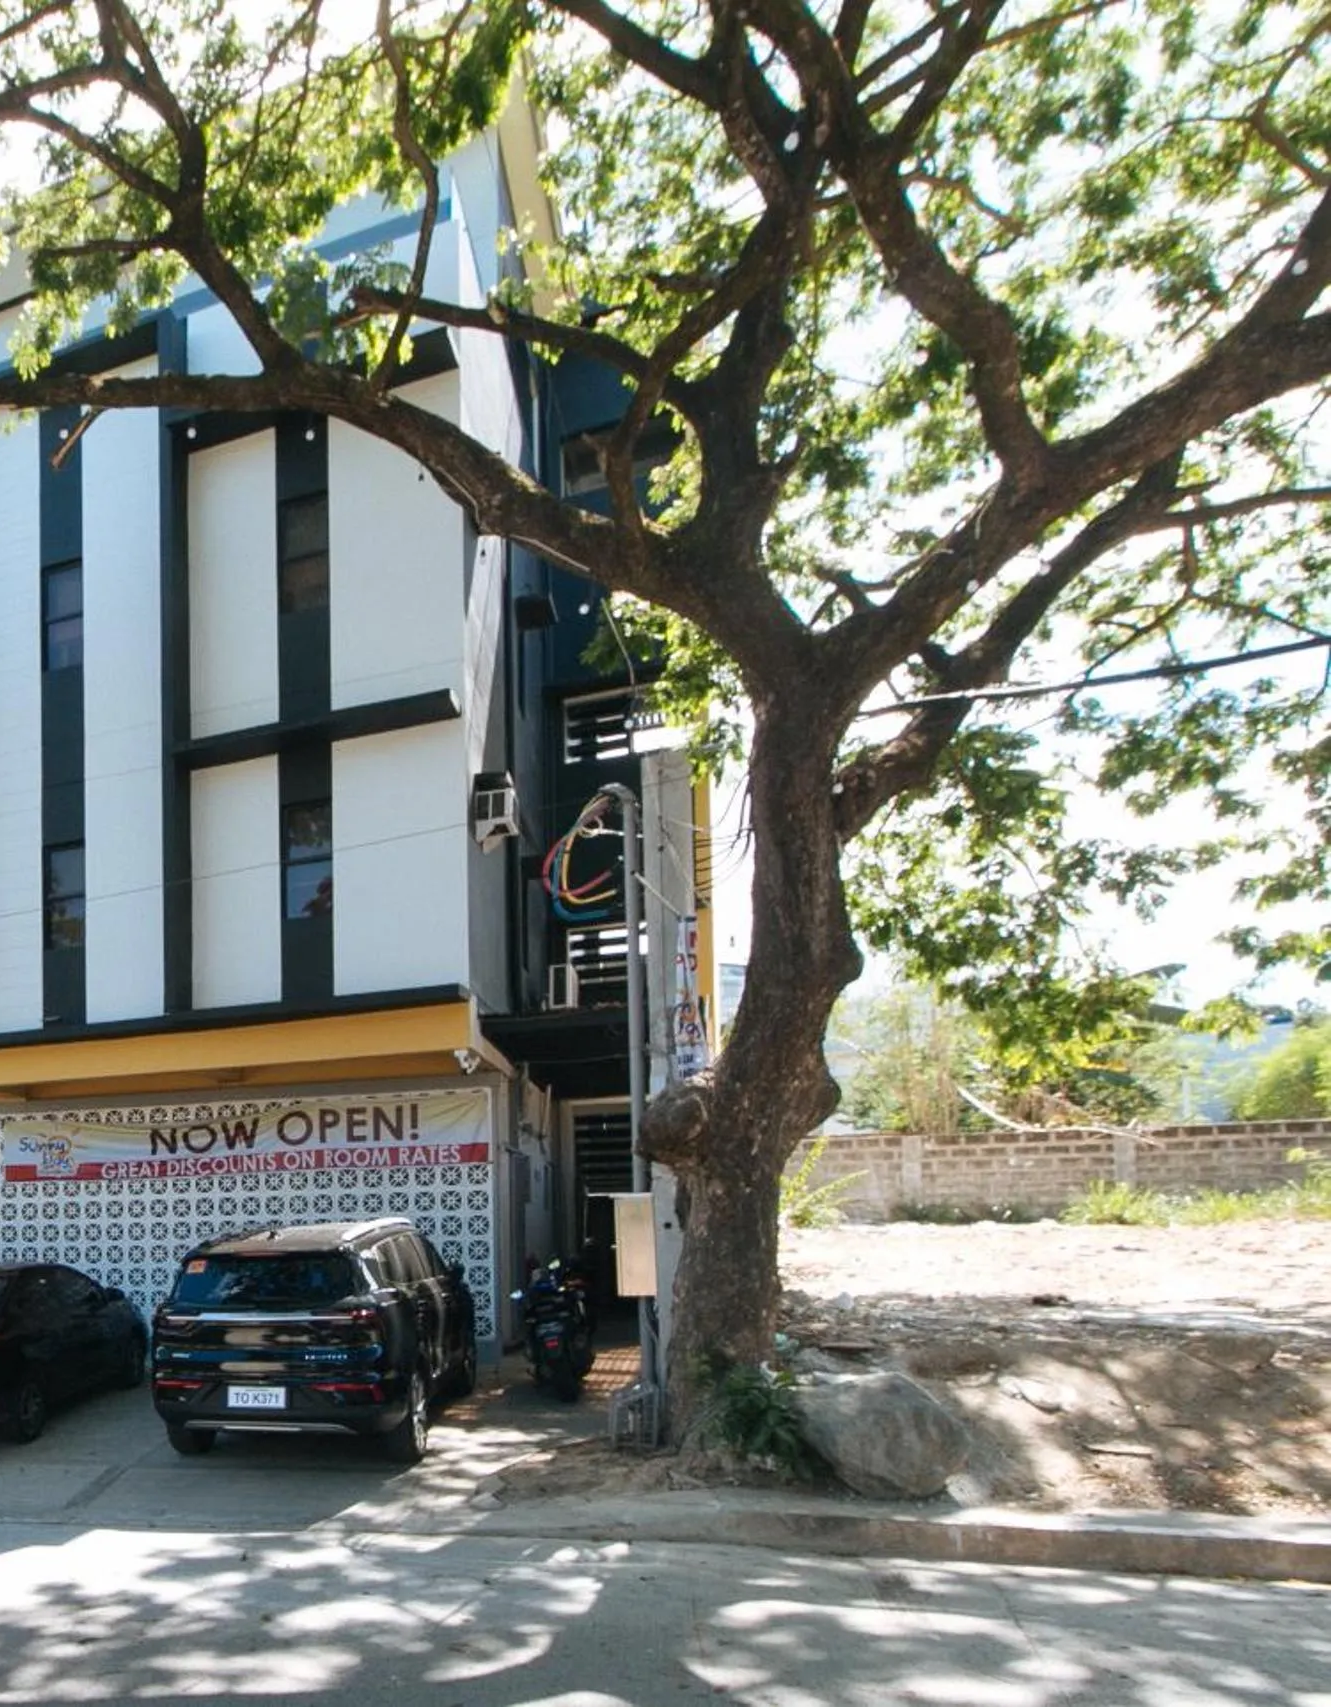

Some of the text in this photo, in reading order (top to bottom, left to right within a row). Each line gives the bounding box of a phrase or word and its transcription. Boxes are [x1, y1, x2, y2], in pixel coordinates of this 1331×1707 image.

[149, 1103, 419, 1156] NOW OPEN!
[101, 1146, 461, 1179] GREAT DISCOUNTS ON ROOM RATES
